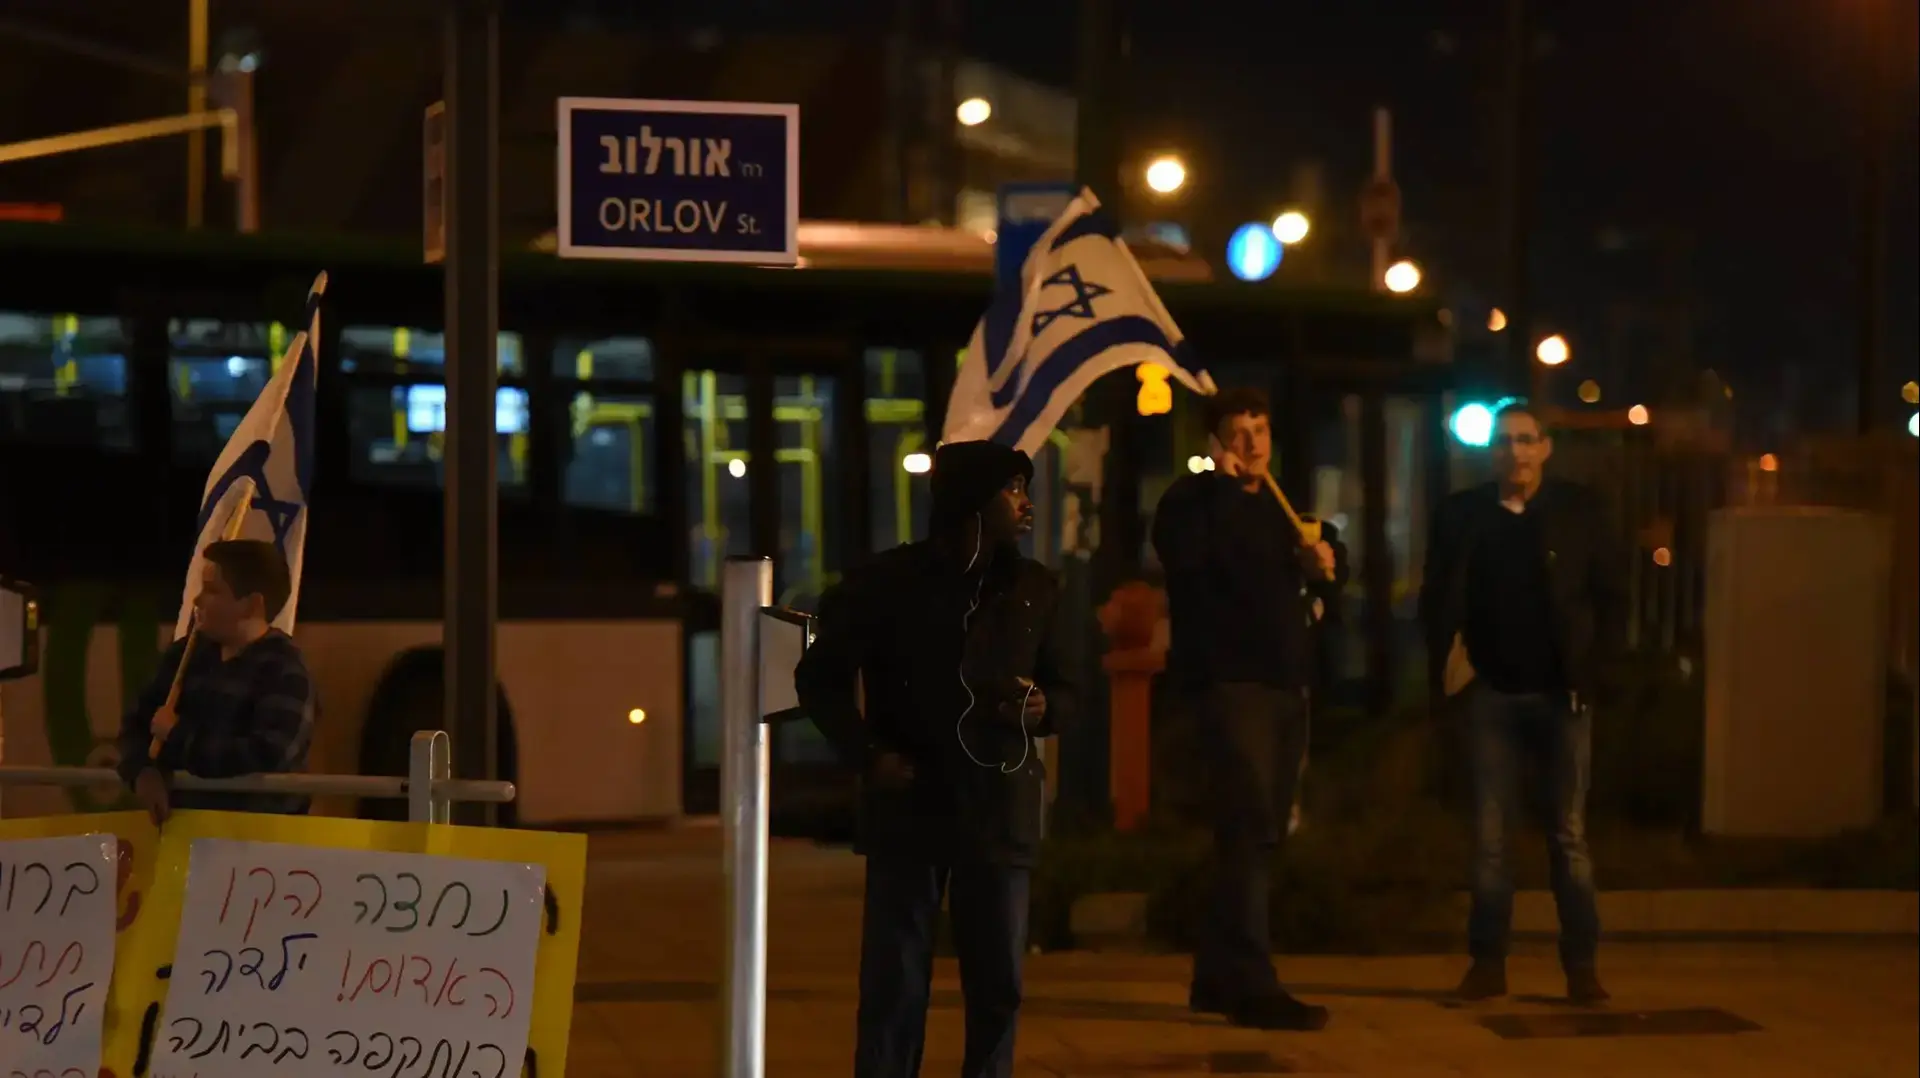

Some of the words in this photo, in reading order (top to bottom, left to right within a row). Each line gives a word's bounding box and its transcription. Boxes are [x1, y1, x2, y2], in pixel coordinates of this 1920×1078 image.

[598, 125, 732, 177] אורלוב
[599, 197, 728, 233] ORLOV
[736, 213, 762, 235] St.
[0, 861, 99, 916] ברו
[354, 872, 509, 936] נחצה
[200, 933, 318, 994] ילדה
[336, 950, 515, 1019] האדום!
[0, 982, 95, 1045] ילדי
[169, 1017, 309, 1065] בביתה
